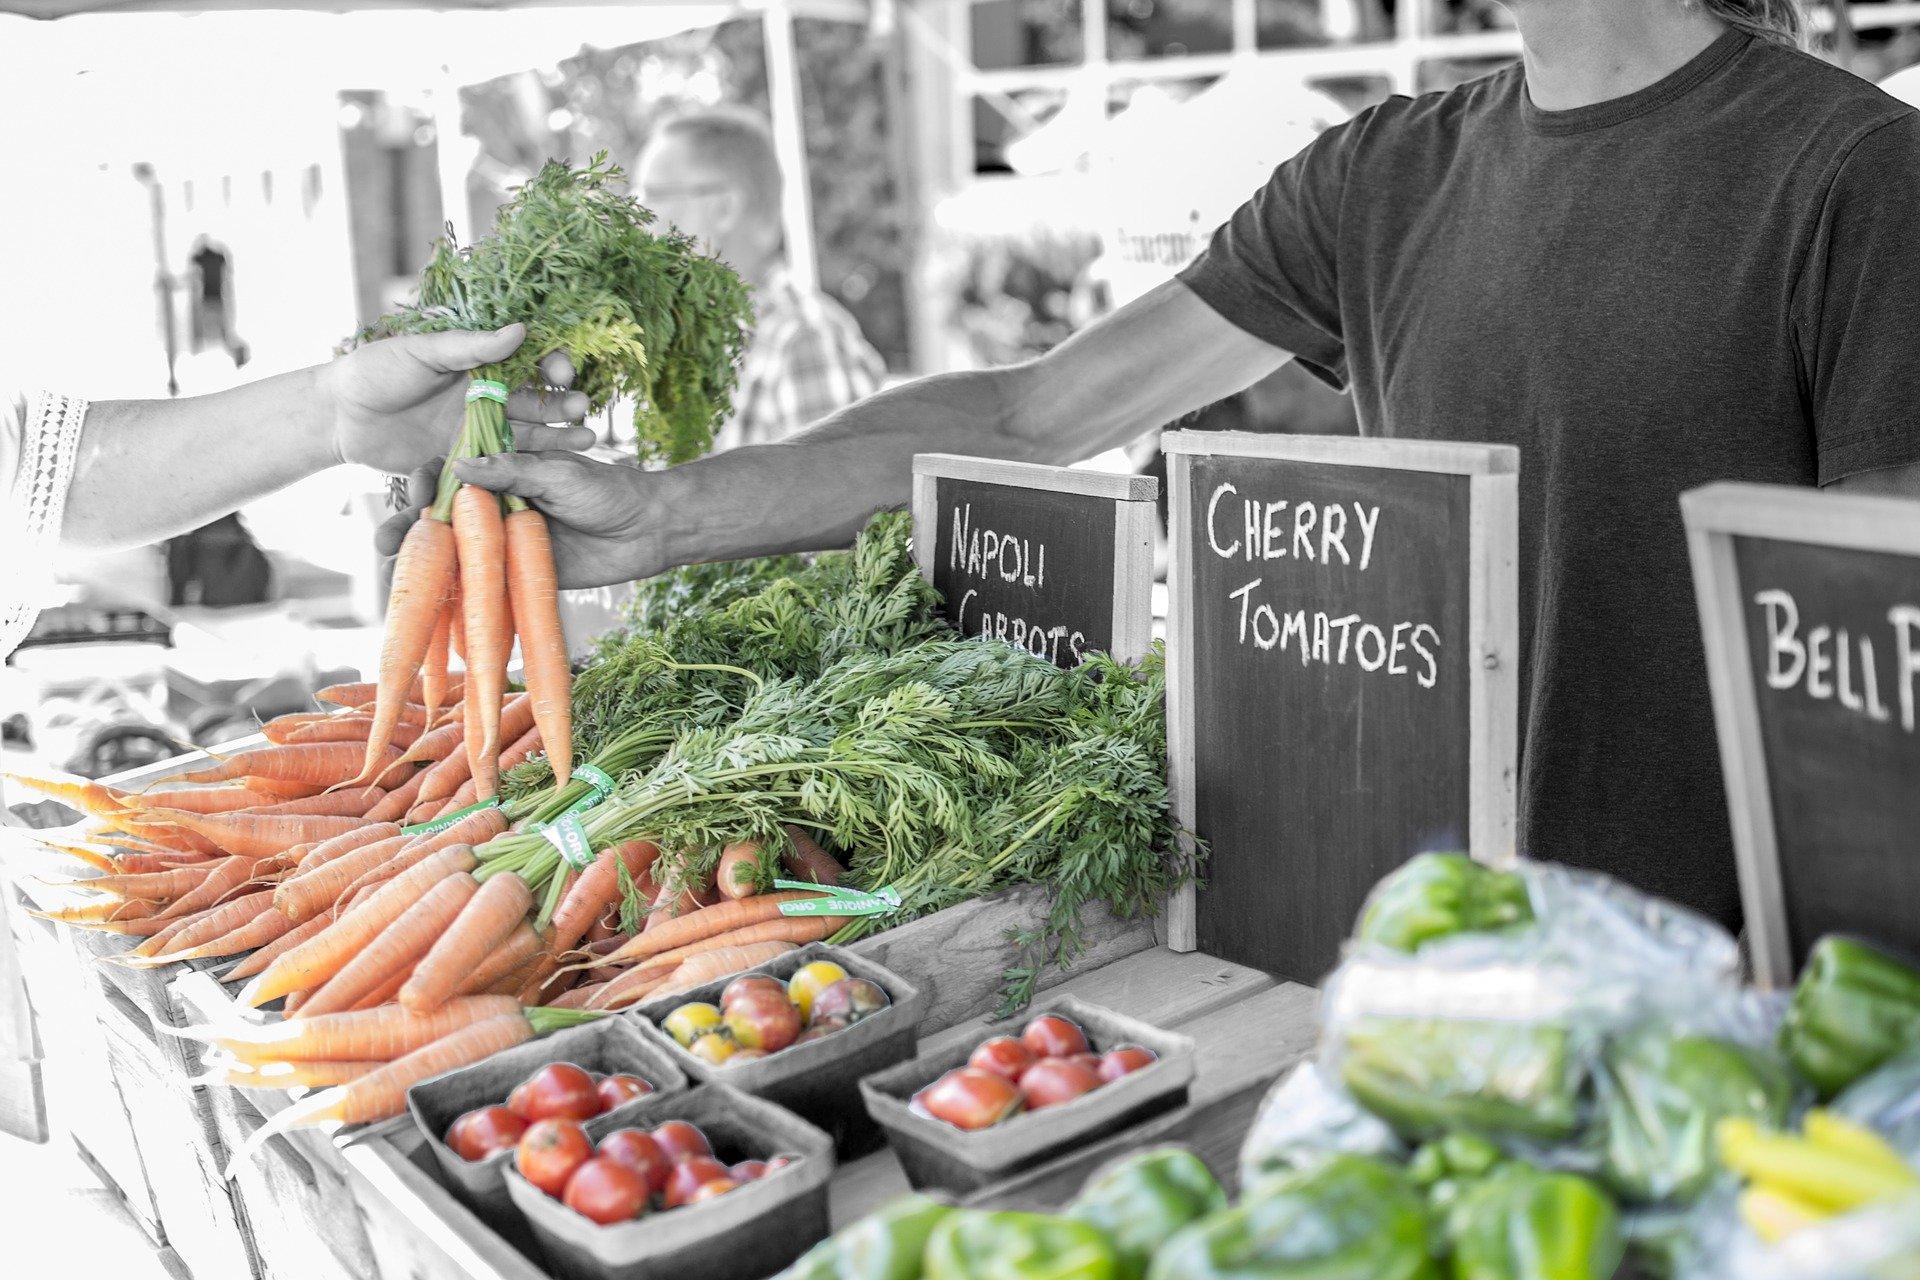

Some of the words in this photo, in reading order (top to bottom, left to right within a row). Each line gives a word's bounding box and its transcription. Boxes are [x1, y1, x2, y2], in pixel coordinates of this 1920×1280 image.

[950, 502, 1045, 589] NAPOLI
[1207, 482, 1381, 571] CHERRY
[1228, 577, 1442, 689] TOMATOES
[1753, 588, 1891, 723] BELL
